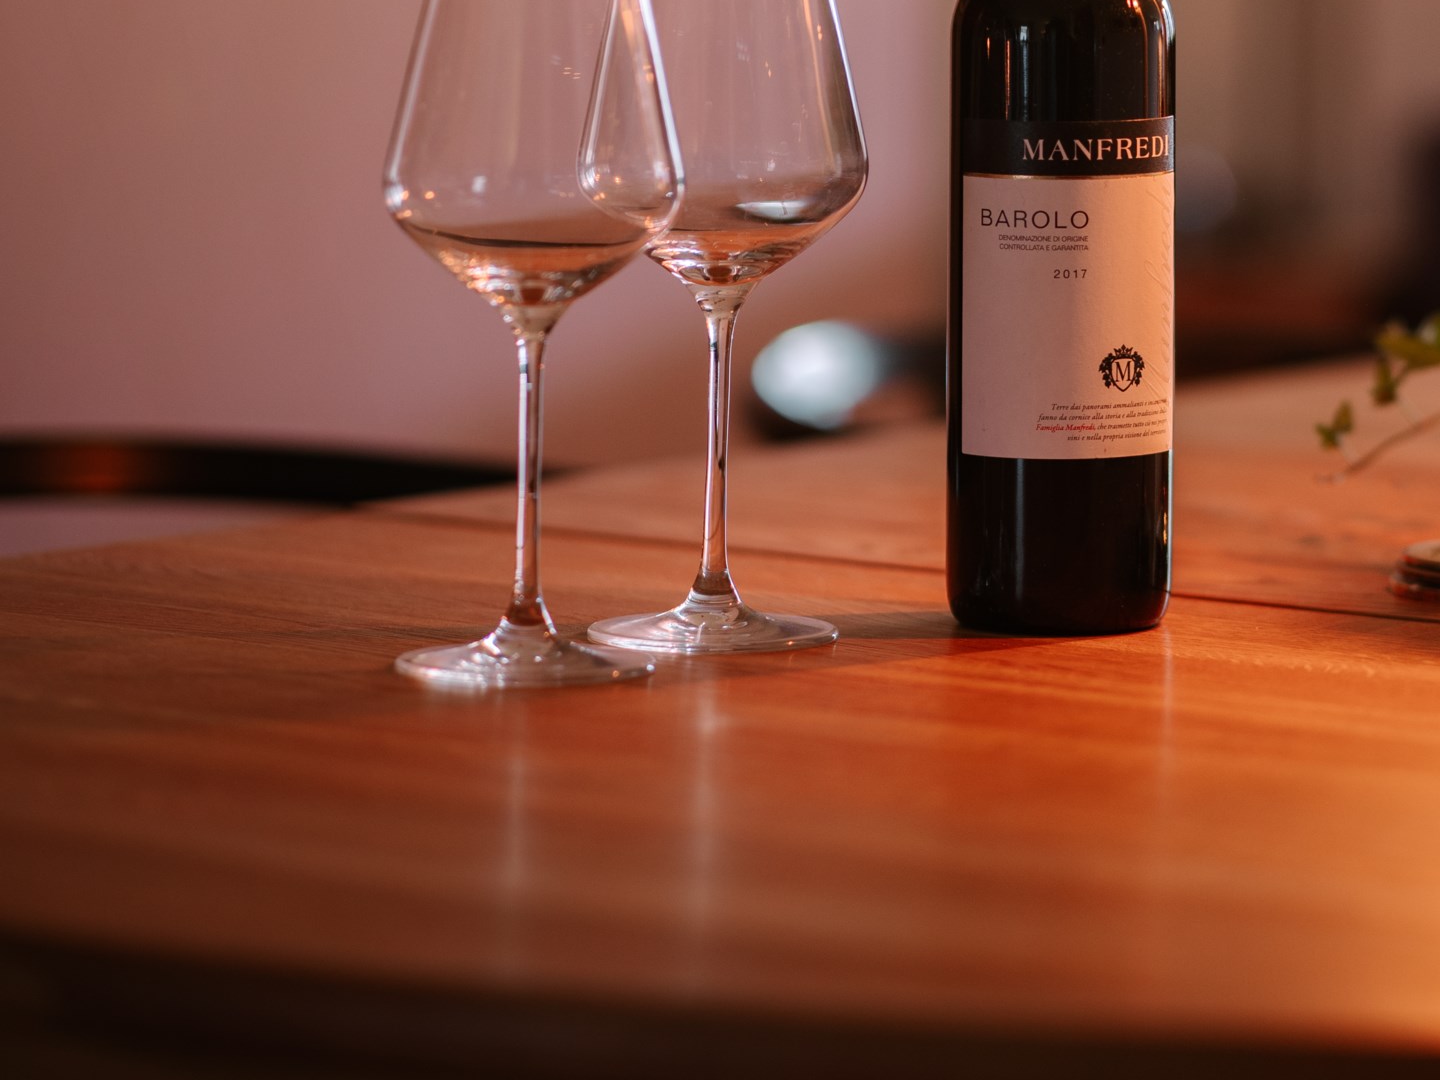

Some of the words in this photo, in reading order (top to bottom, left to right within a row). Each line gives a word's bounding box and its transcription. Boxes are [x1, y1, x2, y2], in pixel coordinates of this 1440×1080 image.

[1022, 134, 1169, 161] MANFREDI
[981, 208, 1089, 229] BAROLO
[999, 234, 1052, 242] DENOMINAZIONE
[1061, 235, 1089, 243] ORIGINE
[999, 243, 1044, 251] CONTROLLATA
[1053, 269, 1088, 279] 2017
[1115, 361, 1133, 382] M
[1070, 402, 1081, 410] dai
[1081, 403, 1112, 413] panorami
[1037, 413, 1058, 422] fanno
[1091, 412, 1104, 420] alla
[1126, 410, 1136, 418] alla
[1035, 423, 1064, 433] Famiglia
[1097, 422, 1107, 430] che
[1102, 433, 1124, 443] propria
